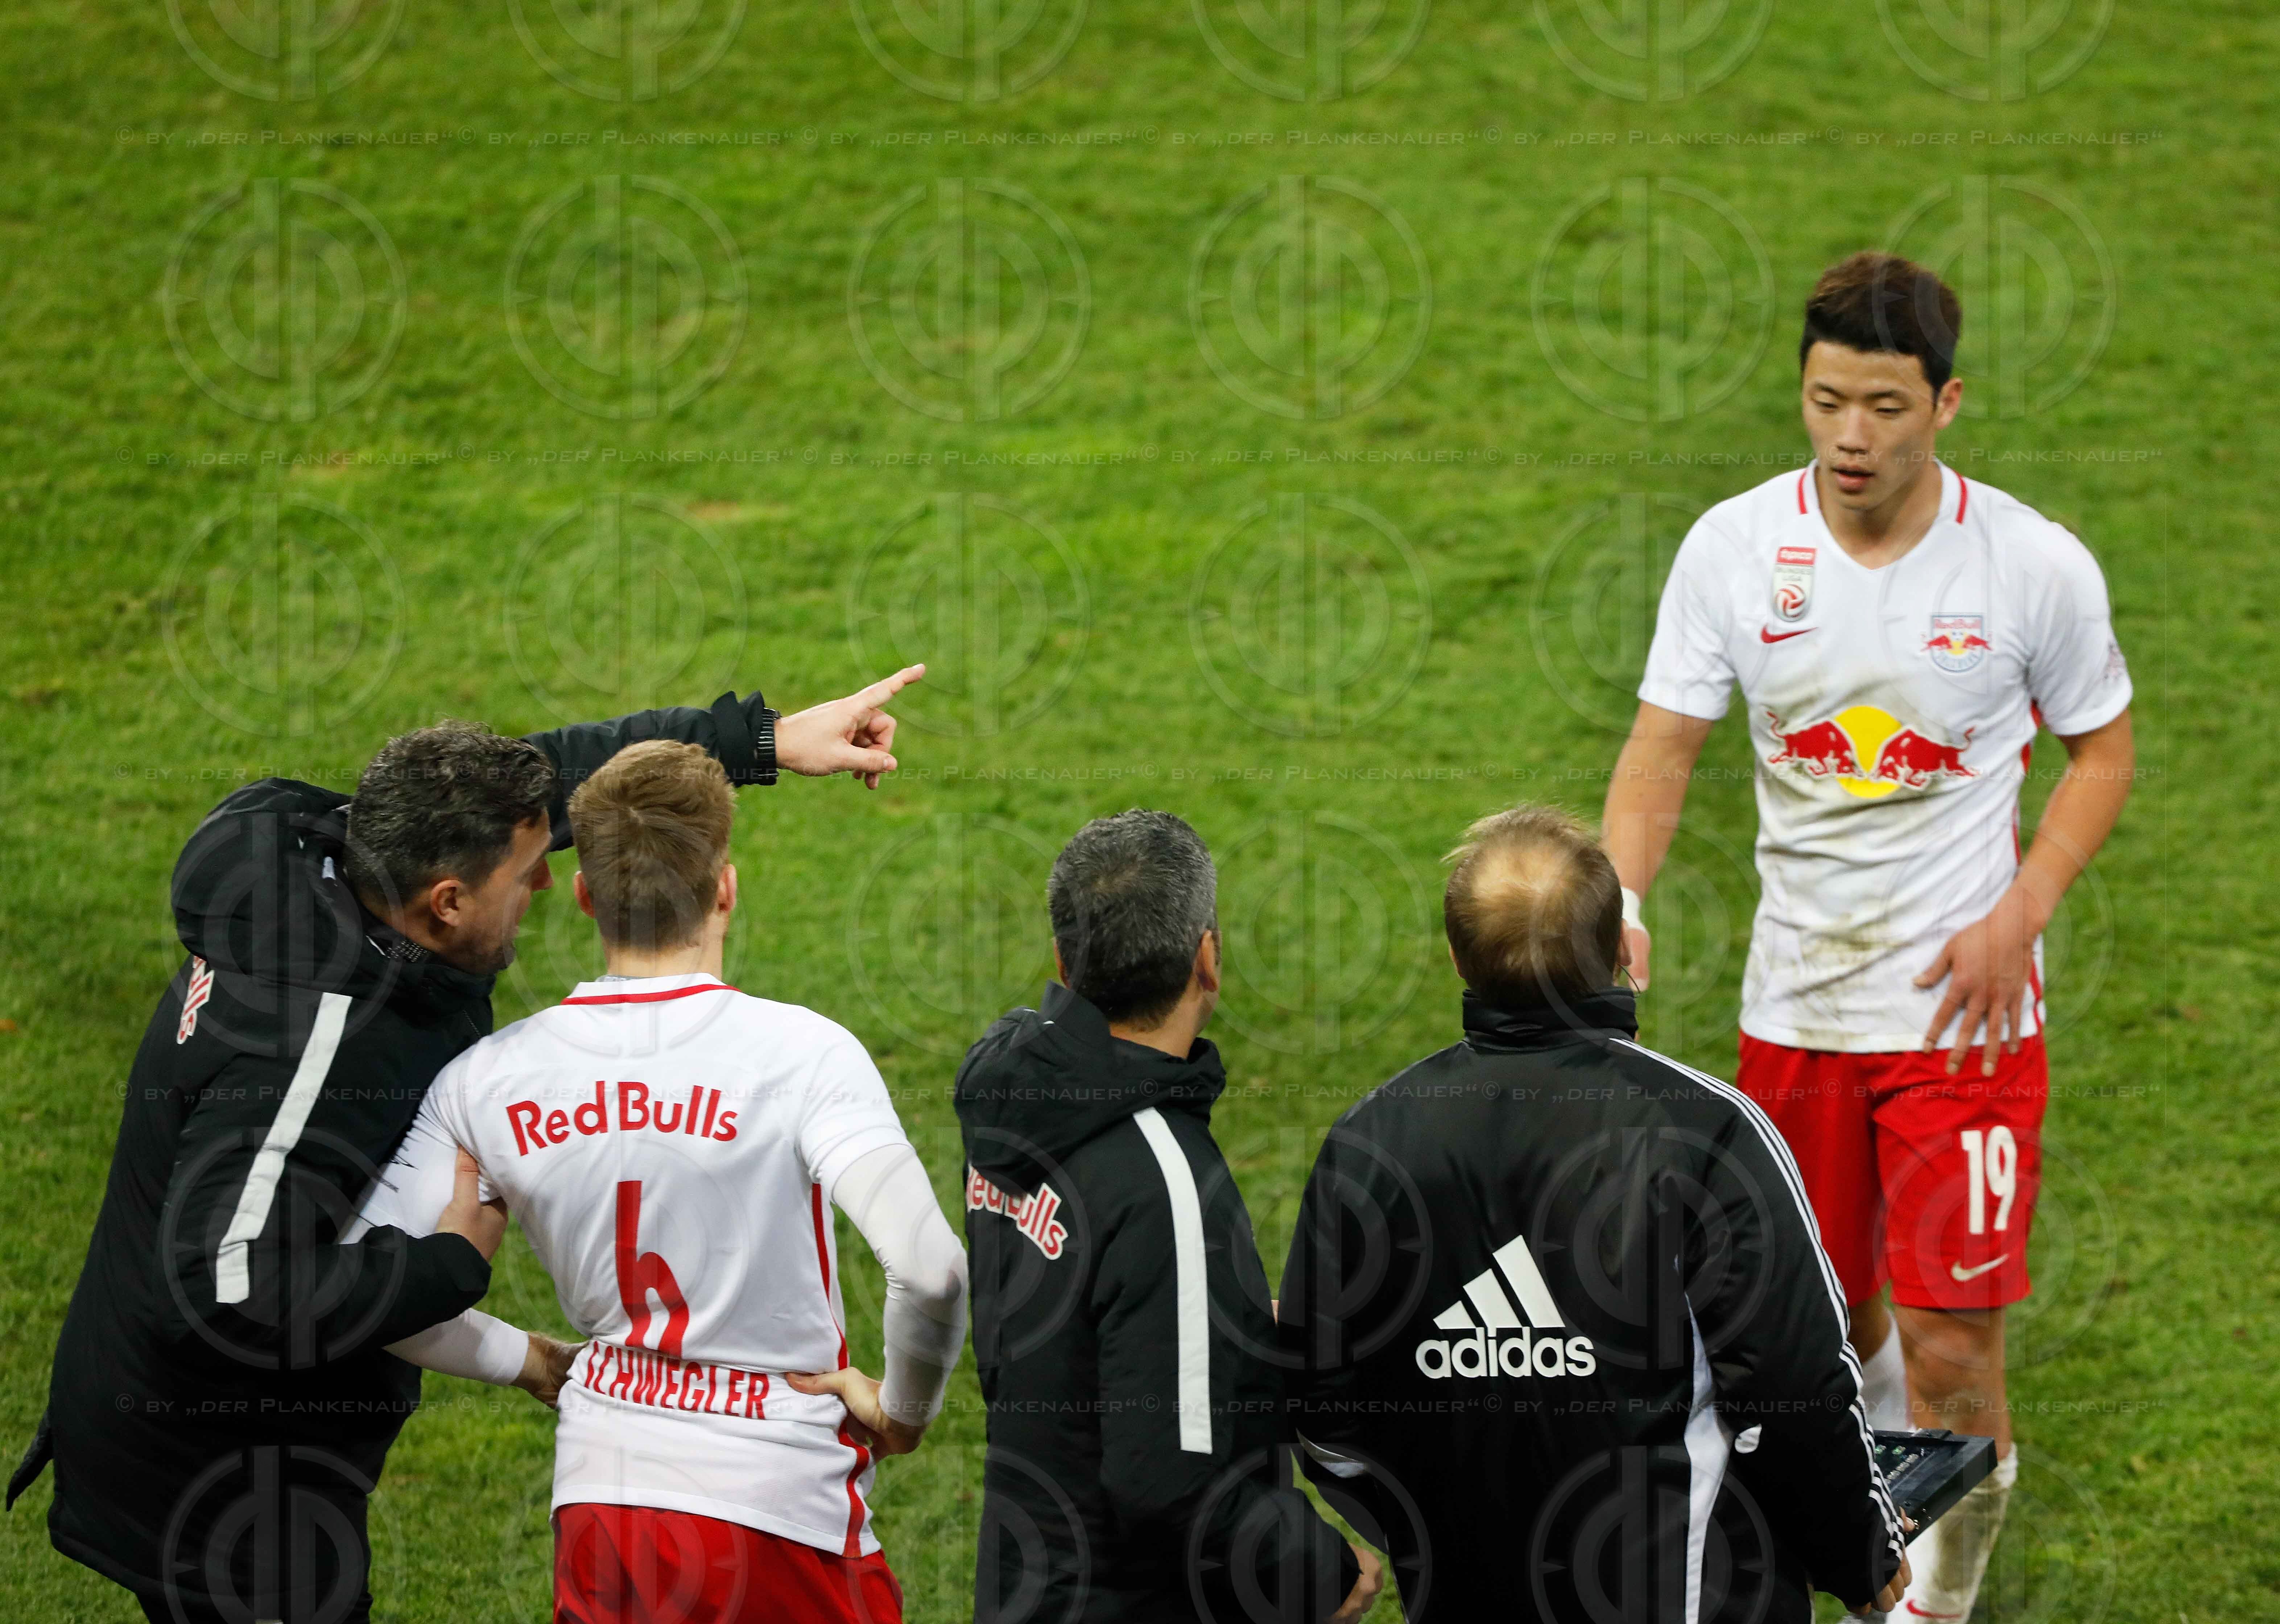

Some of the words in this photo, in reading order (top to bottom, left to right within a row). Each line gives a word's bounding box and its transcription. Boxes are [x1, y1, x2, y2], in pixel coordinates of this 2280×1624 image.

[181, 956, 211, 1040] ulls
[506, 1081, 608, 1156] Red
[618, 1082, 738, 1142] Bulls
[966, 1168, 1003, 1209] ed
[1961, 1124, 2017, 1234] 19
[1415, 1326, 1596, 1379] adidas
